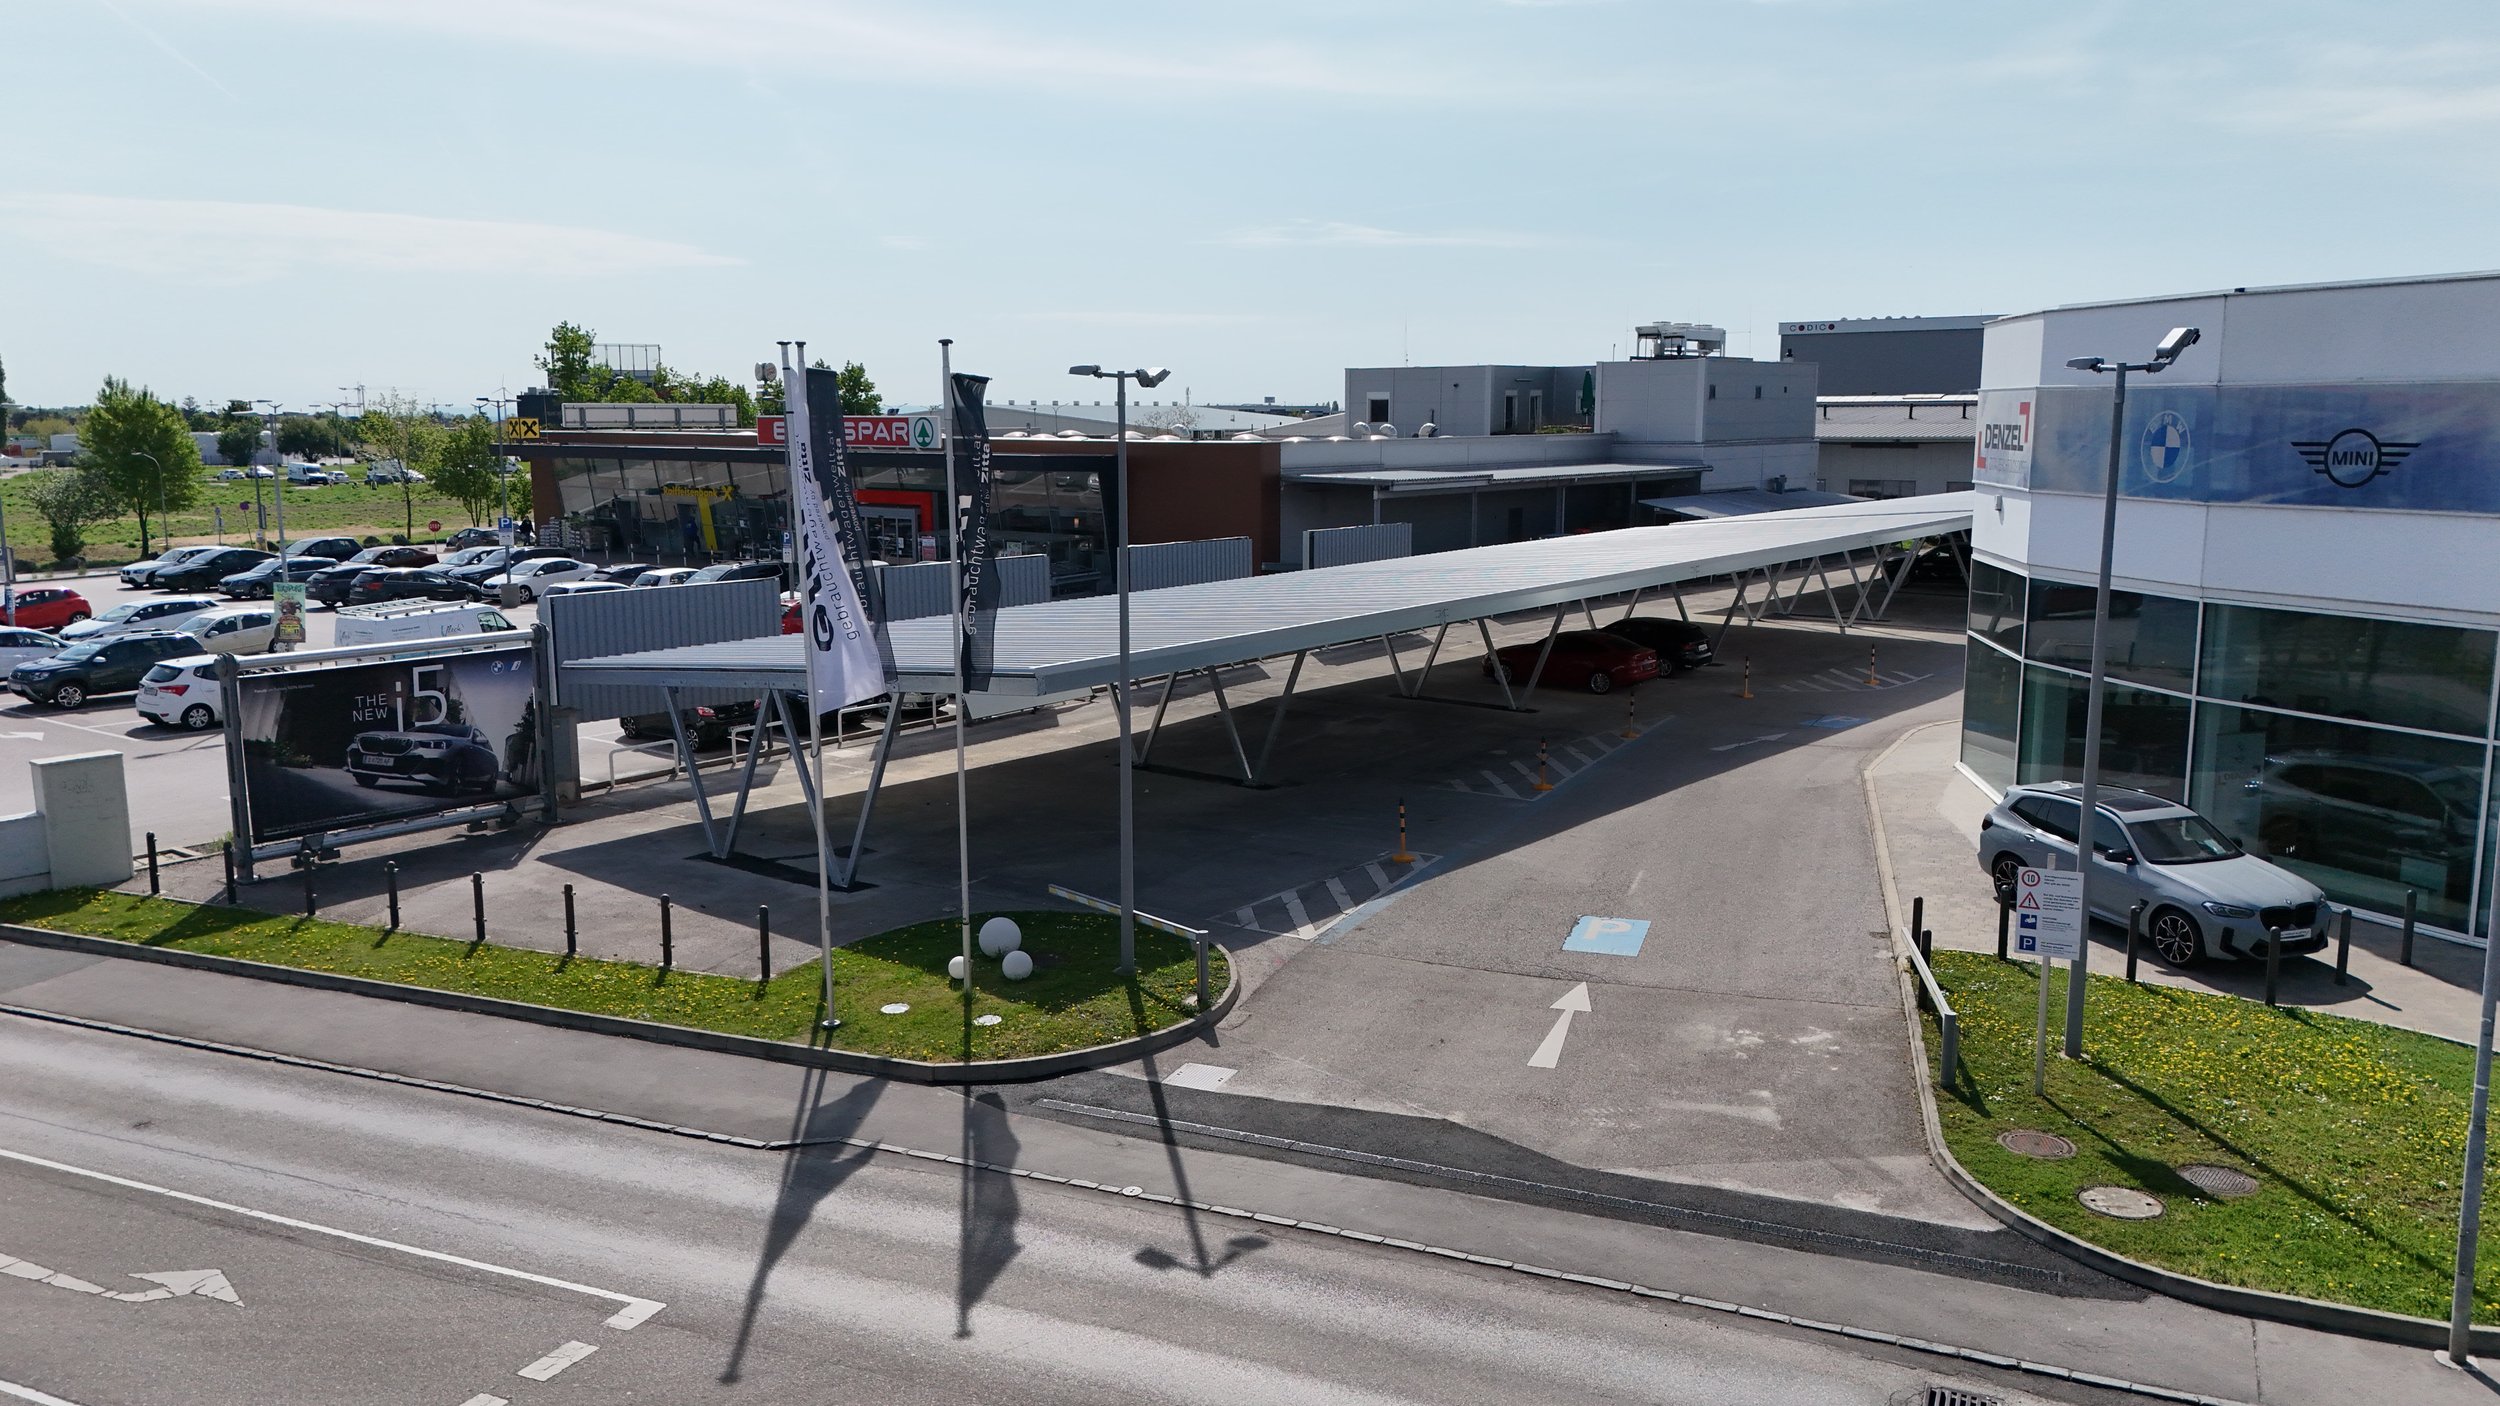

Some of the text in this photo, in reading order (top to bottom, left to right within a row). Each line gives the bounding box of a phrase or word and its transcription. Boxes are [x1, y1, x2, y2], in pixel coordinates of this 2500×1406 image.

[1789, 323, 1835, 332] CODICO
[773, 421, 908, 442] ESPAR
[2149, 414, 2186, 434] BMW
[1984, 423, 2024, 451] DENZEL
[981, 443, 990, 484] Zitta
[2332, 450, 2374, 466] MINI
[800, 442, 830, 541] powered by Zitta
[836, 438, 862, 531] powered by Zitta
[501, 518, 510, 528] P
[827, 429, 869, 617] brauchtwagenwelt.at
[784, 532, 790, 543] P
[795, 433, 860, 641] gebrauchtwag.at
[968, 433, 987, 635] gebrauchtwaglt.at
[355, 693, 388, 708] THE
[395, 664, 448, 733] i5
[352, 707, 388, 722] NEW
[2026, 873, 2036, 883] 10
[1583, 918, 1632, 940] P
[2023, 937, 2033, 949] P
